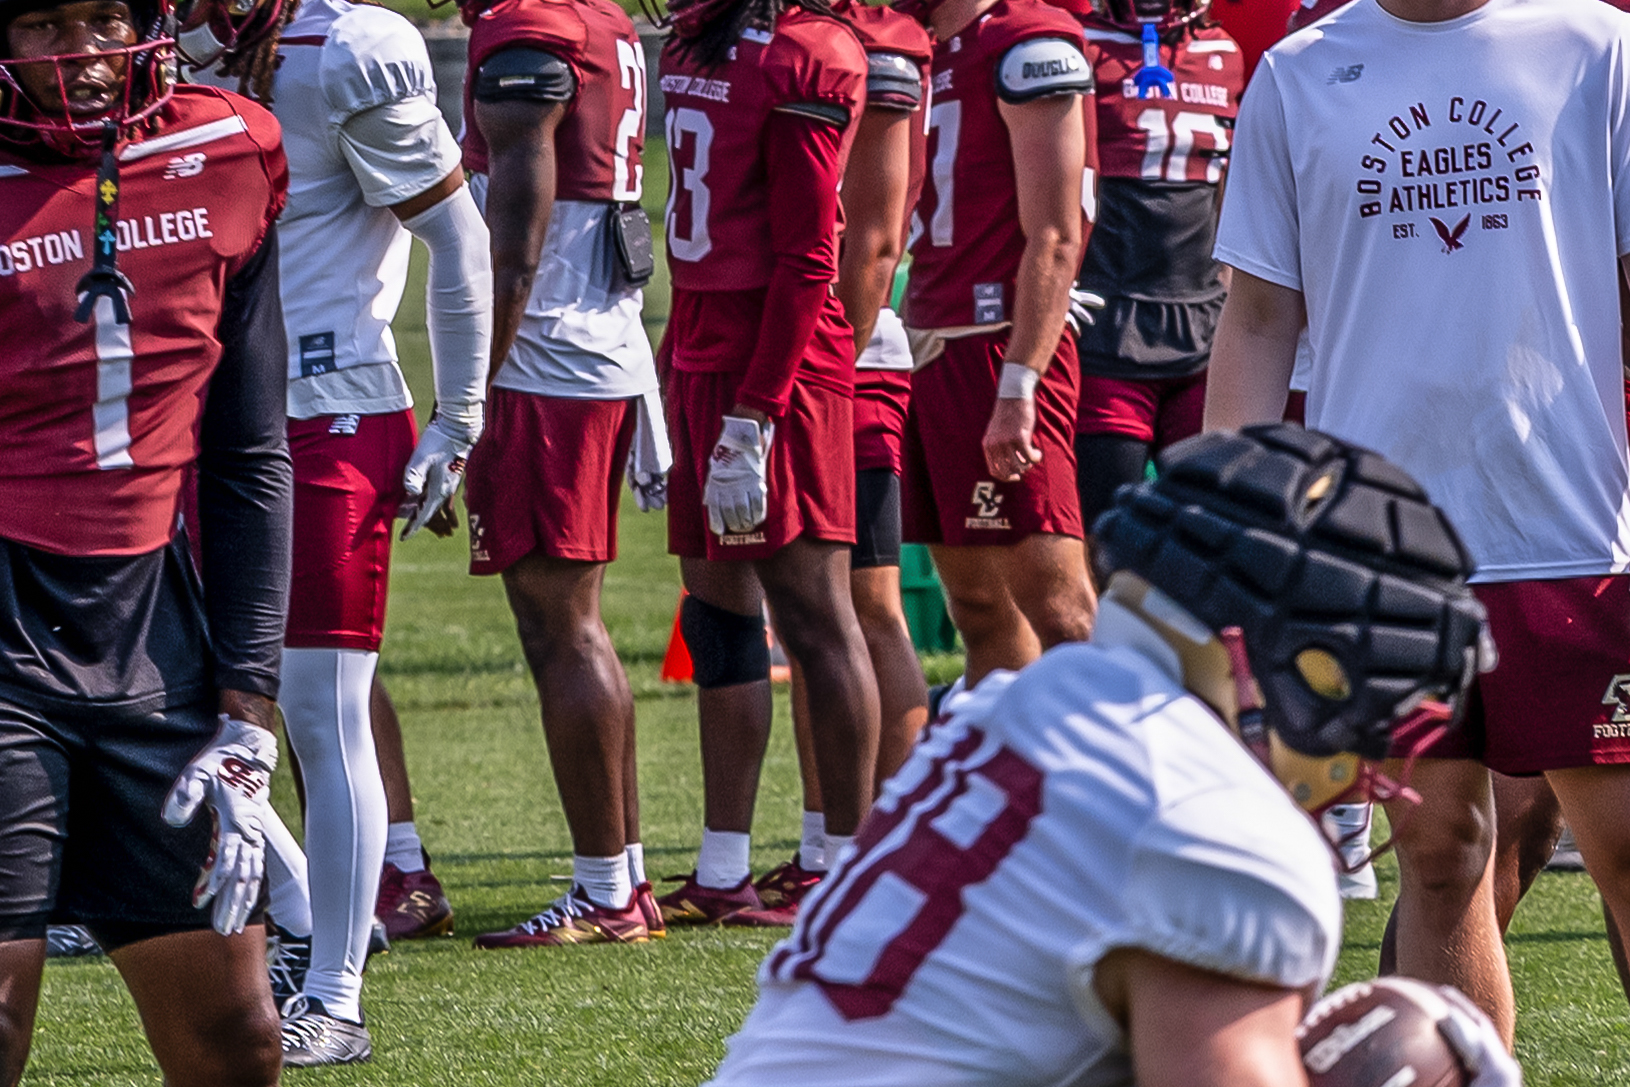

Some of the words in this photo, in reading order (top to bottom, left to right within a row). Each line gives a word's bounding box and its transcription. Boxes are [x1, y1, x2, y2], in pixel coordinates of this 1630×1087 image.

[1356, 101, 1432, 219] BOSTON
[1448, 96, 1543, 202] COLLEGE
[1400, 142, 1492, 178] EAGLES
[1388, 175, 1511, 214] ATHLETICS
[0, 229, 85, 277] OSTON
[115, 207, 214, 252] OLLEGE
[1392, 223, 1420, 240] EST.
[1481, 213, 1509, 230] 1863
